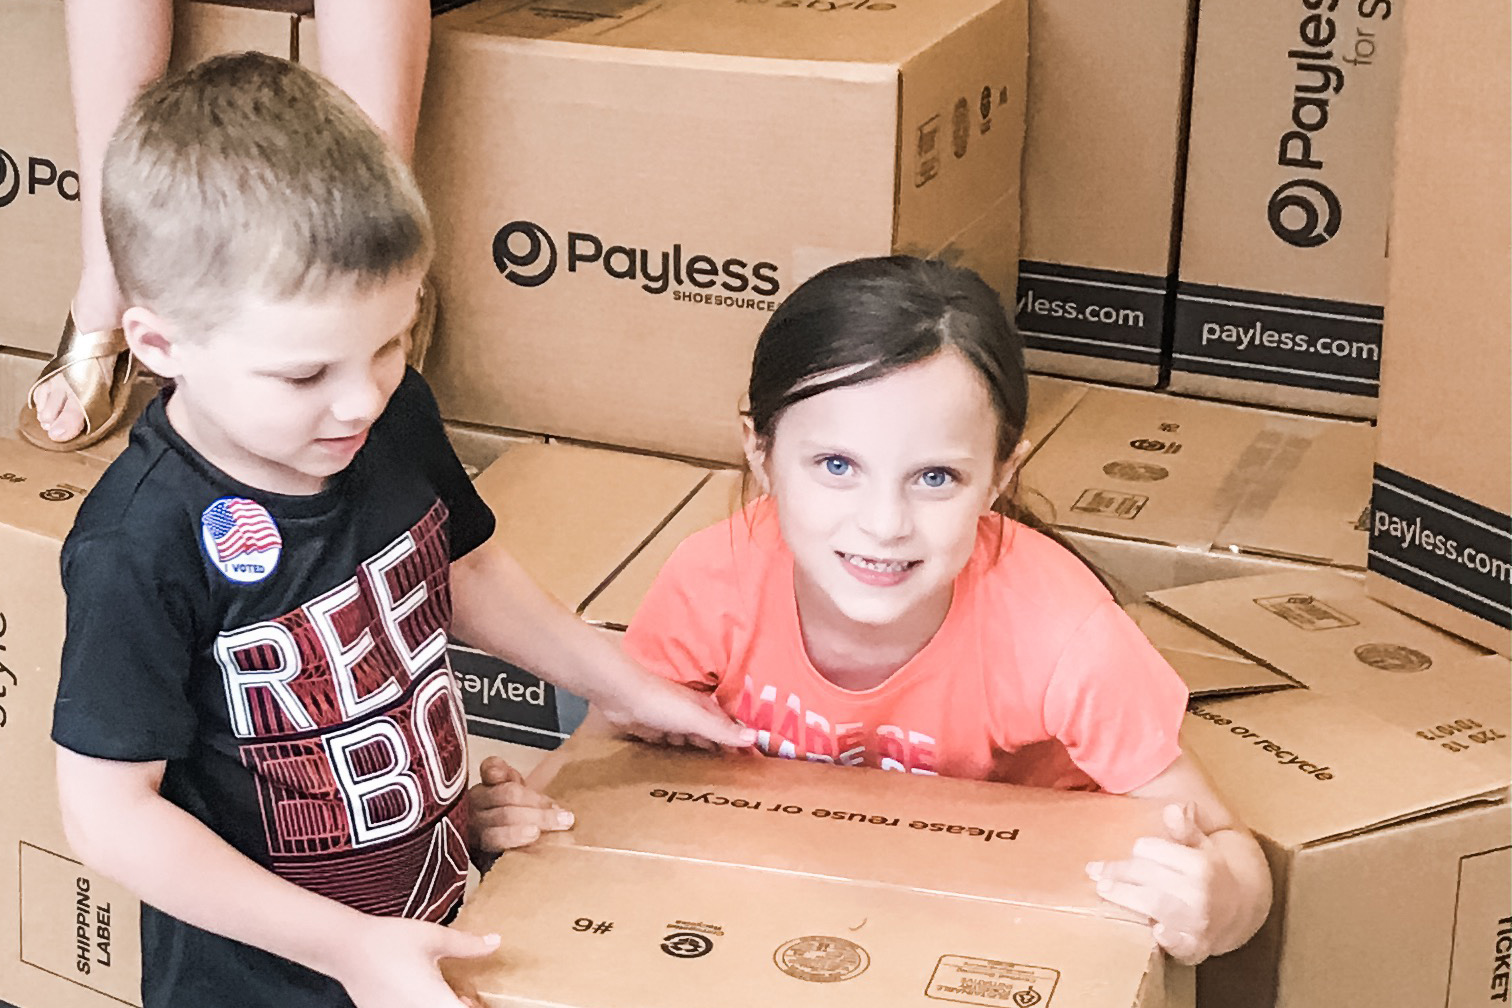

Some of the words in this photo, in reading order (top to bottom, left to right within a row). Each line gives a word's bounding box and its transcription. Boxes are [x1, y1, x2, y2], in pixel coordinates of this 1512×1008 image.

[1343, 28, 1376, 66] for
[568, 231, 780, 296] Payless
[673, 290, 776, 312] SHOESOURCE
[1201, 321, 1379, 361] payless.com
[1374, 510, 1512, 586] payless.com
[223, 563, 229, 573] I
[231, 563, 265, 574] VOTED
[1230, 726, 1260, 740] or
[1253, 738, 1334, 782] recycle
[648, 788, 761, 811] recycle
[766, 802, 803, 815] or
[811, 807, 900, 827] reuse
[908, 819, 1020, 842] please
[76, 877, 92, 976] SHIPPING
[96, 901, 113, 968] LABEL
